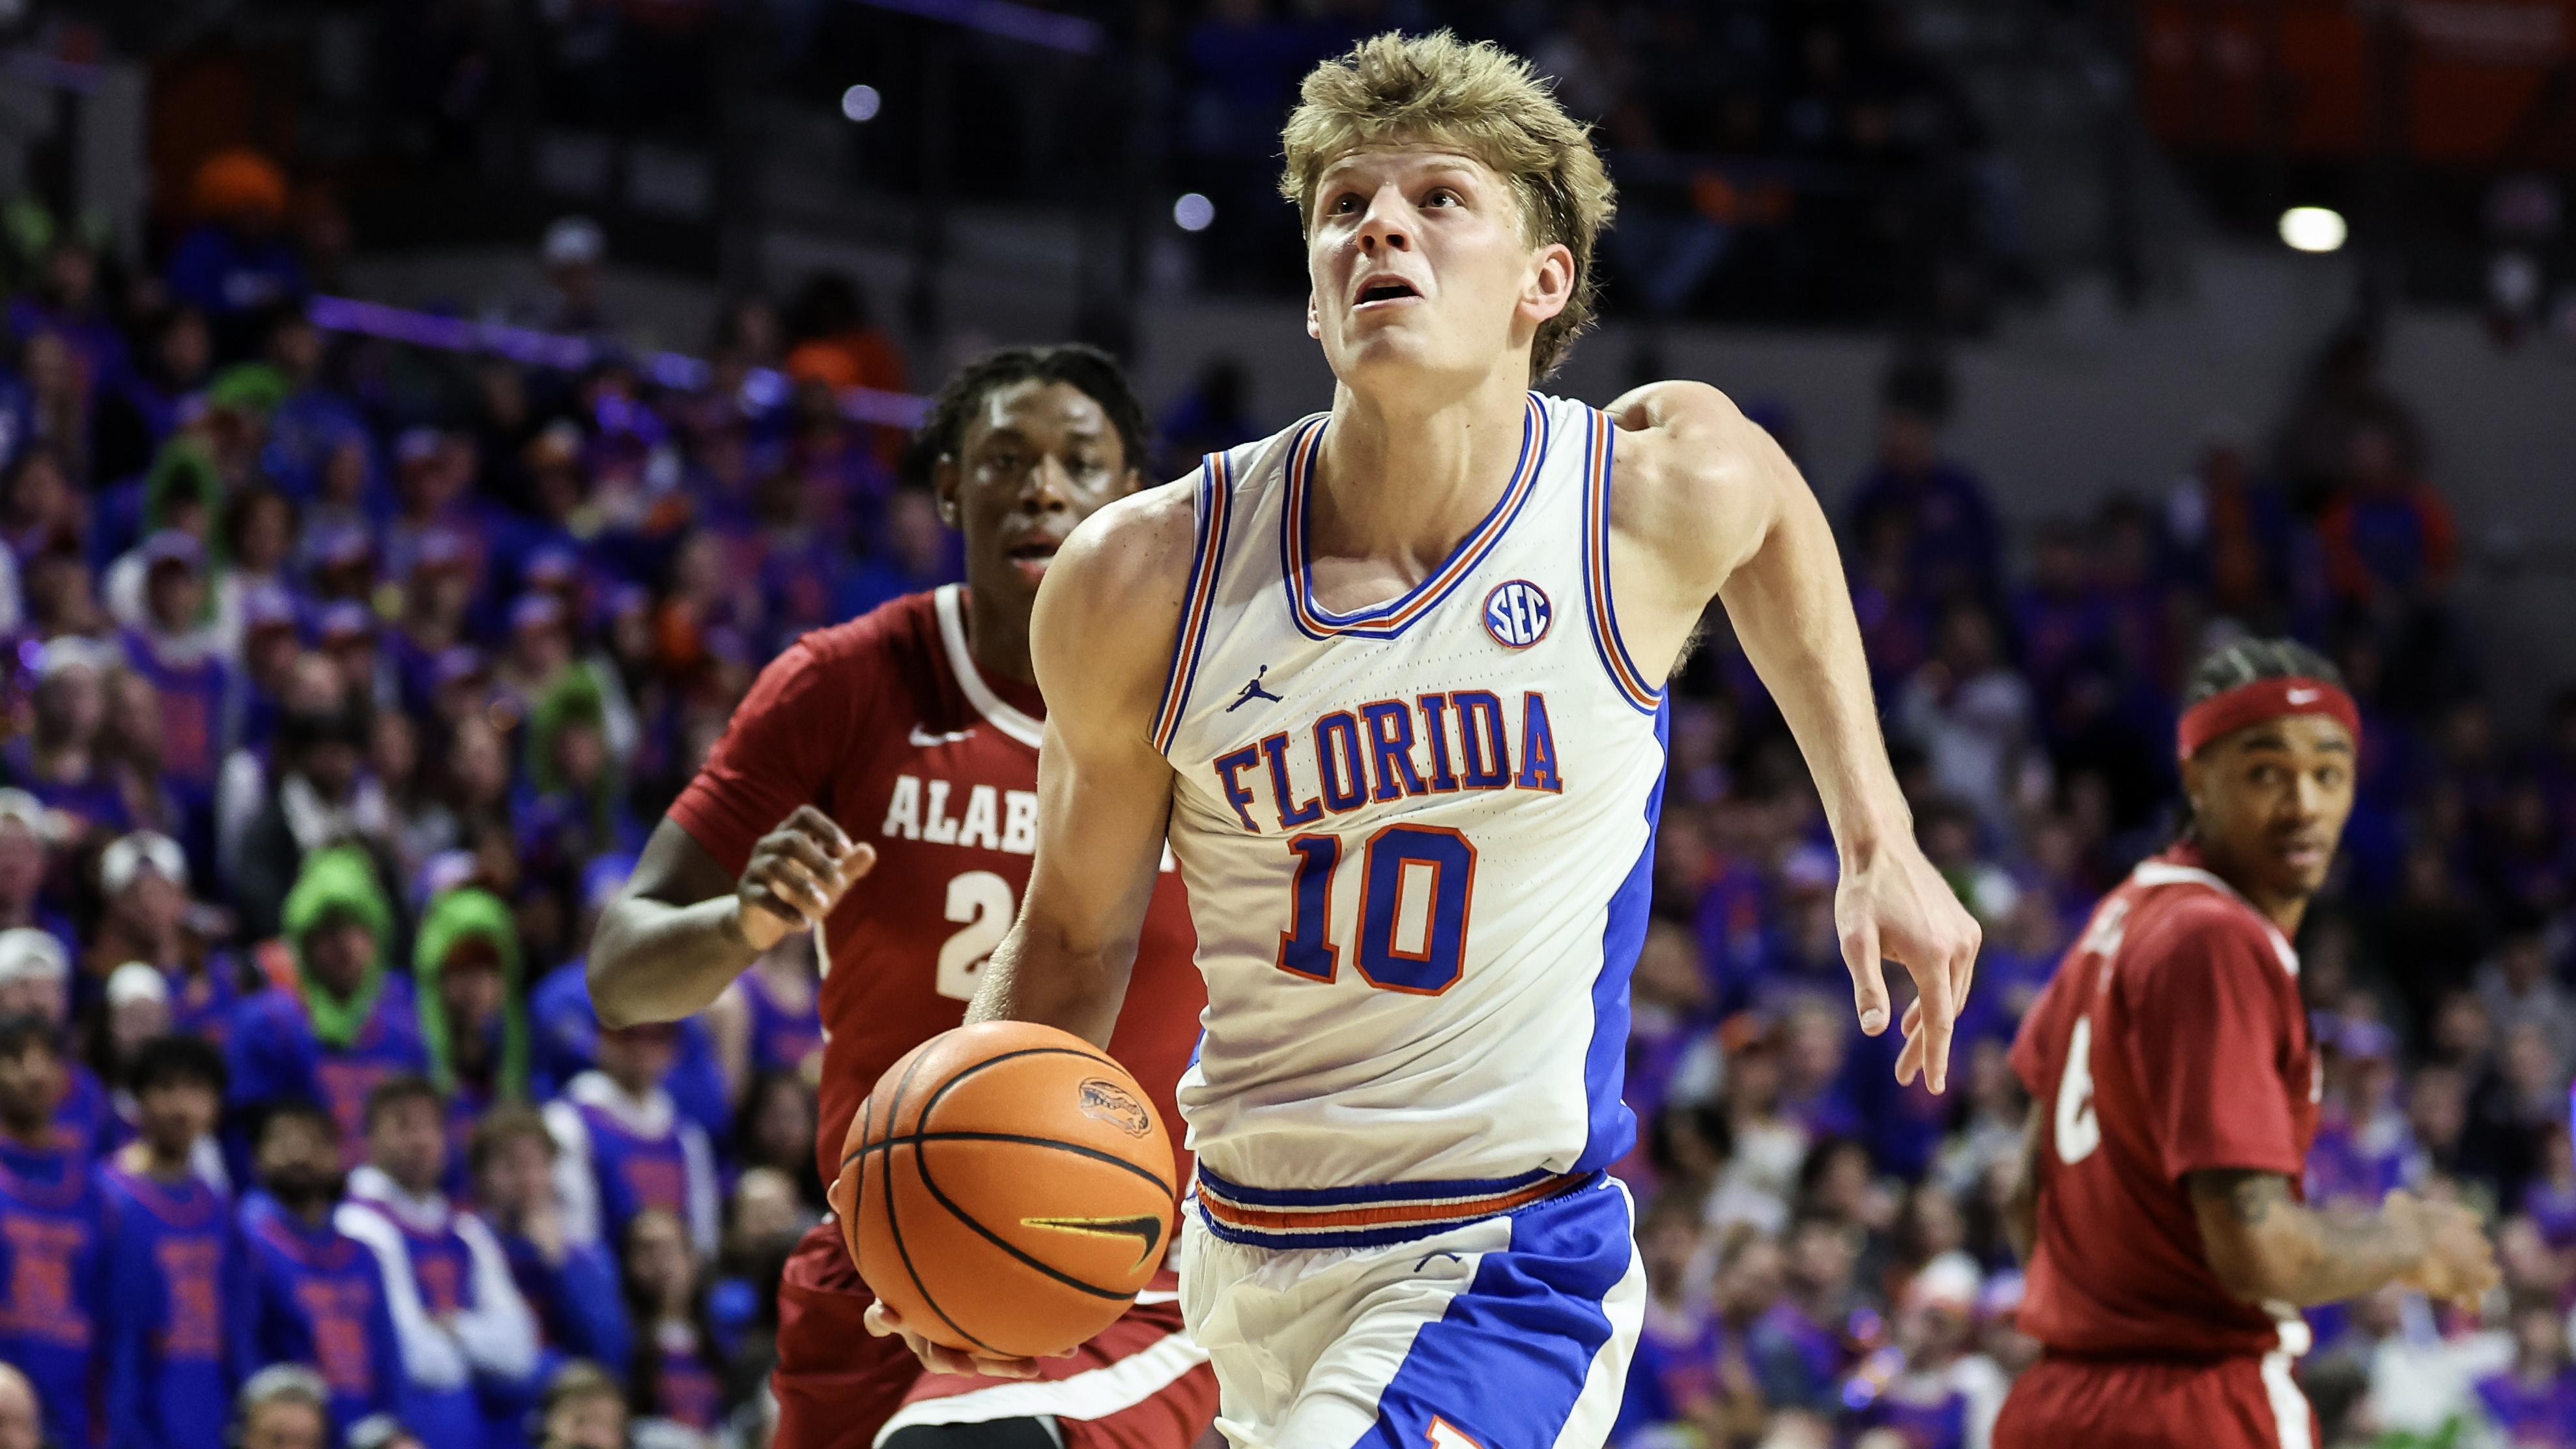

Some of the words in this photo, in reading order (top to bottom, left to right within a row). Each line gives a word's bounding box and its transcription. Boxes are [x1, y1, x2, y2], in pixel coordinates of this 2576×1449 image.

[1488, 584, 1547, 644] SEC
[1213, 689, 1563, 834] FLORIDA
[1276, 822, 1478, 997] 10
